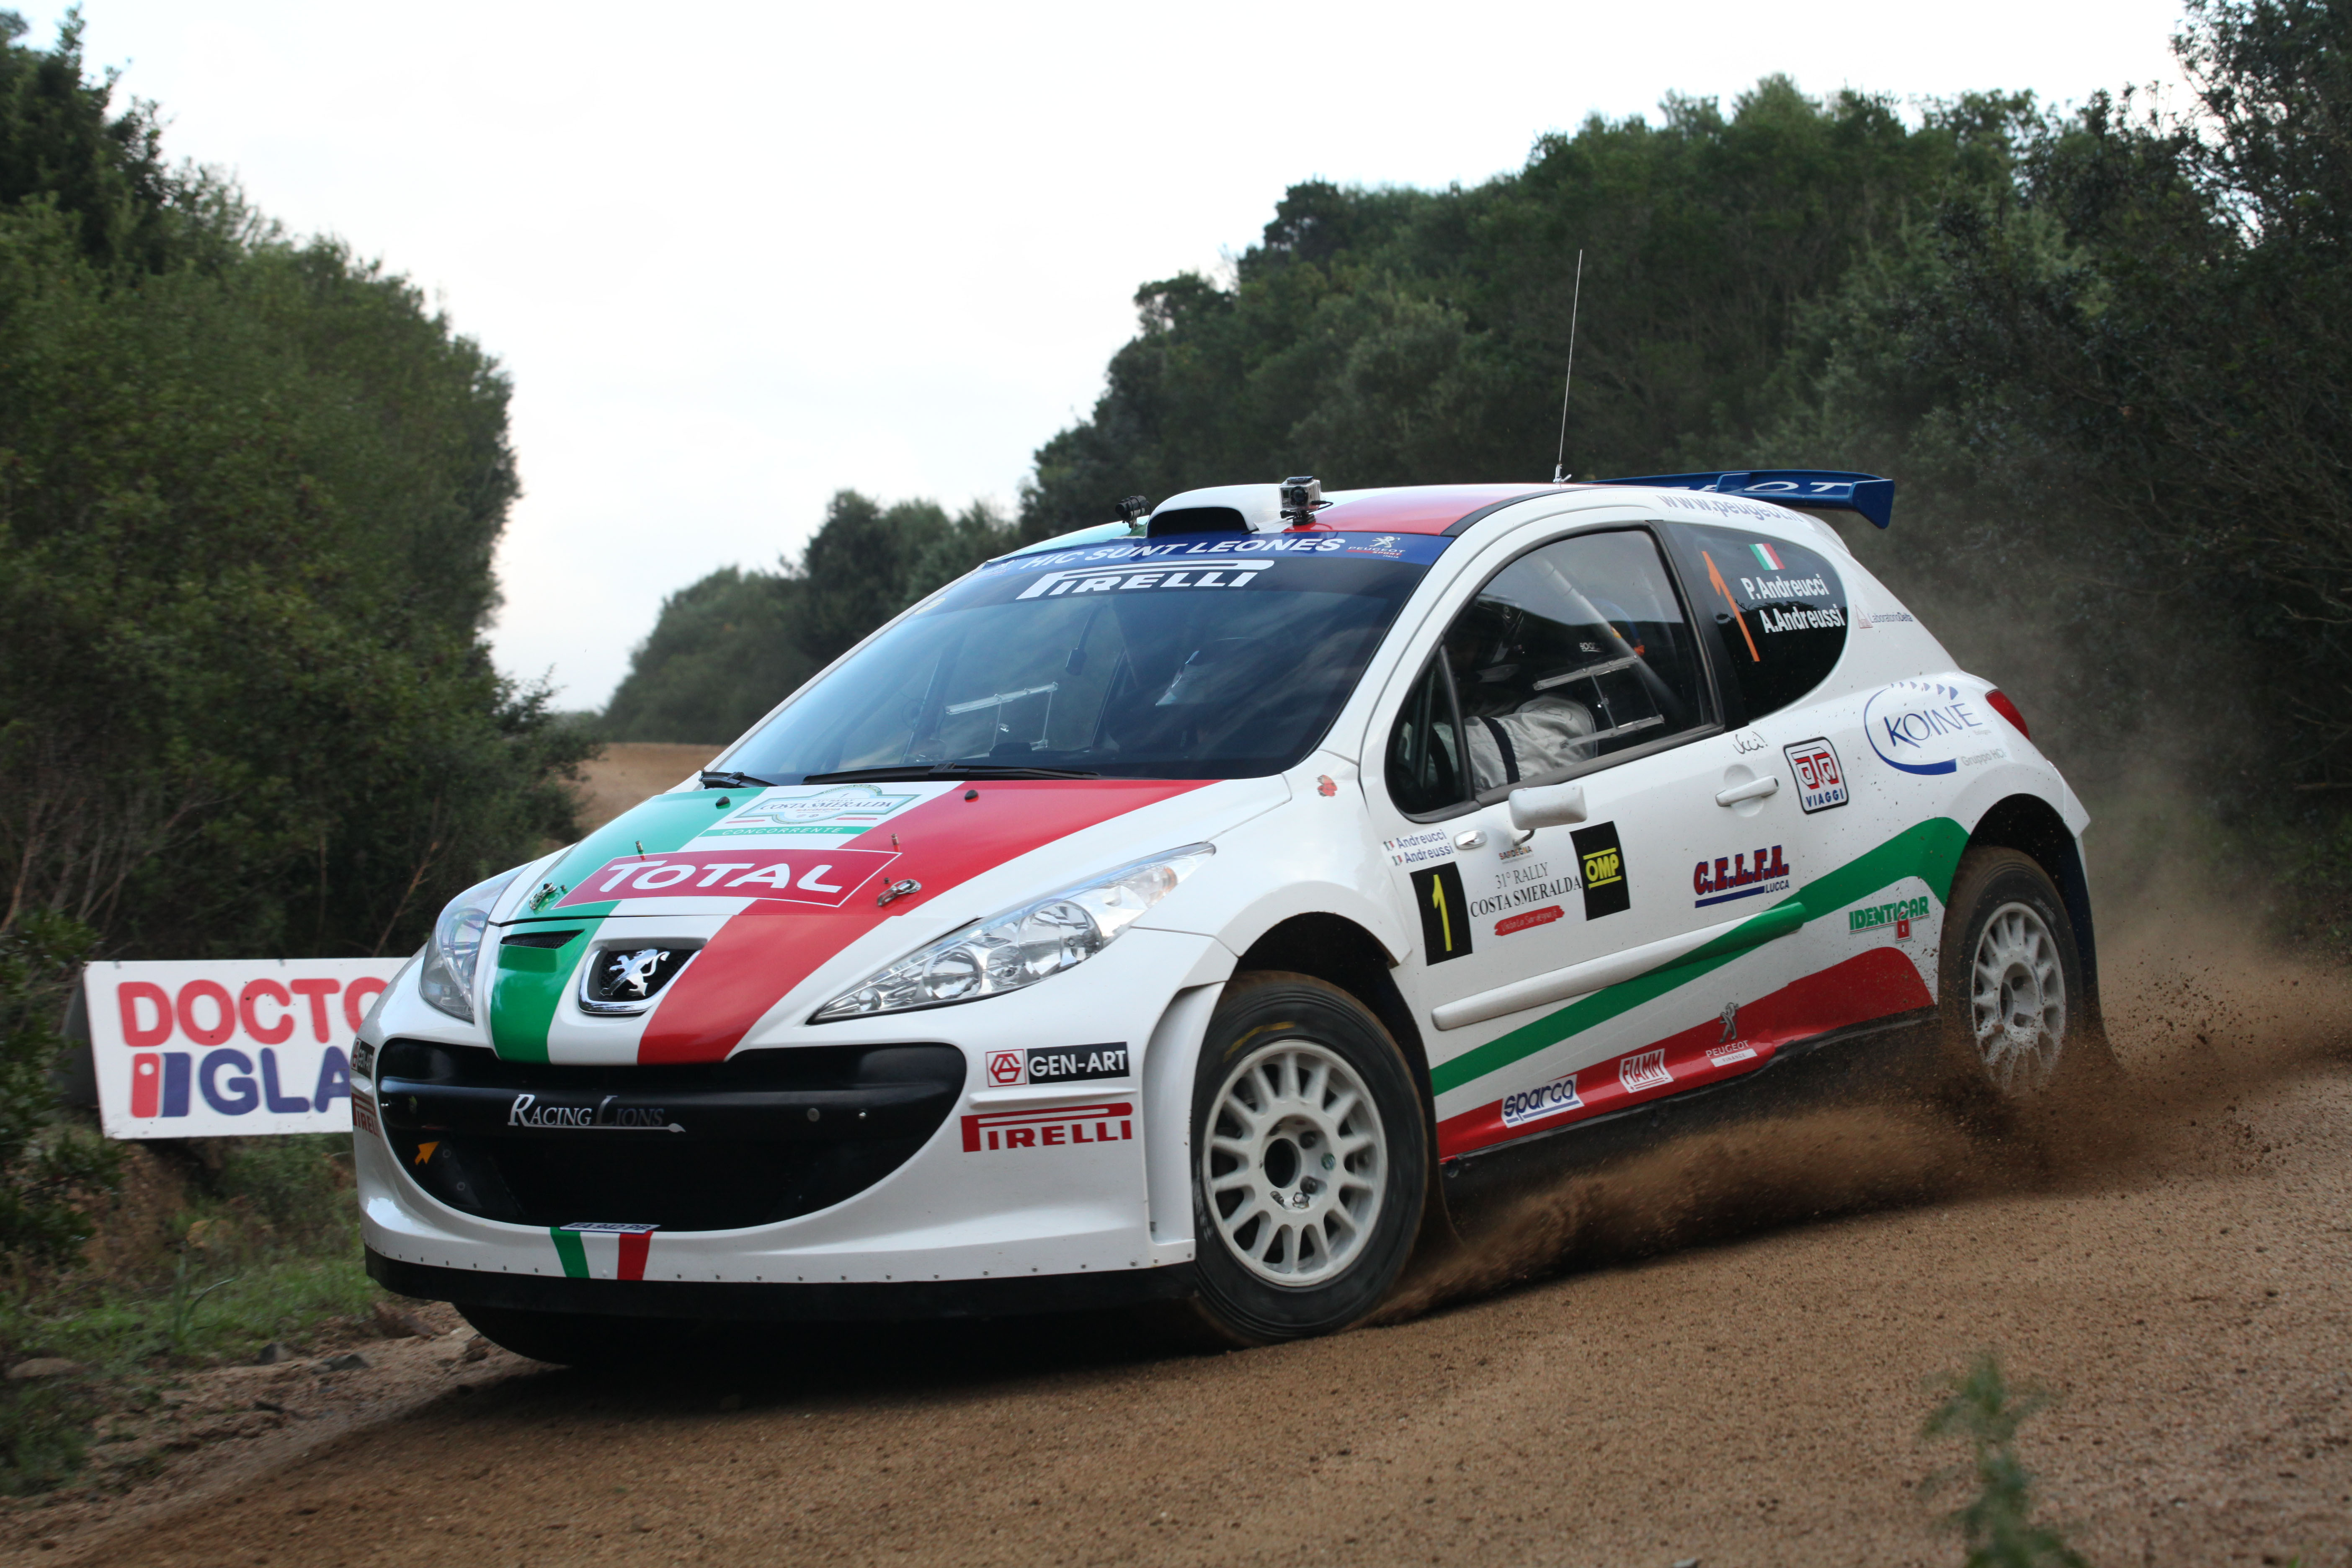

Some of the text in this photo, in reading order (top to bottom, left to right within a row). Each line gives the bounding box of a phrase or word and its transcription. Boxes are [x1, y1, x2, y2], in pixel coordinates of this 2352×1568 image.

[1020, 538, 1346, 569] HIC SUNT LEONES
[1016, 560, 1274, 600] PIRELLI
[1702, 551, 1760, 662] 1
[1961, 753, 1992, 766] Gruppo
[807, 801, 892, 810] SMERALDA
[1805, 788, 1844, 807] VIAGGI
[1396, 829, 1447, 849] Andreucci
[1404, 843, 1454, 863] Andreussi
[599, 860, 843, 893] TOTAL
[1513, 862, 1548, 884] RALLY
[1585, 854, 1620, 882] OMP
[1470, 875, 1582, 917] COSTA SMERALDA
[1766, 879, 1790, 894] LUCCA
[1432, 874, 1452, 952] 1
[1849, 896, 1929, 930] IDENTICAR
[1706, 1040, 1749, 1057] PEUGEOT
[1722, 1053, 1746, 1062] FINANCE
[1029, 1050, 1126, 1077] GEN-ART
[1622, 1050, 1666, 1085] FIAMM
[1504, 1079, 1574, 1120] sparco
[961, 1102, 1133, 1153] PIRELLI
